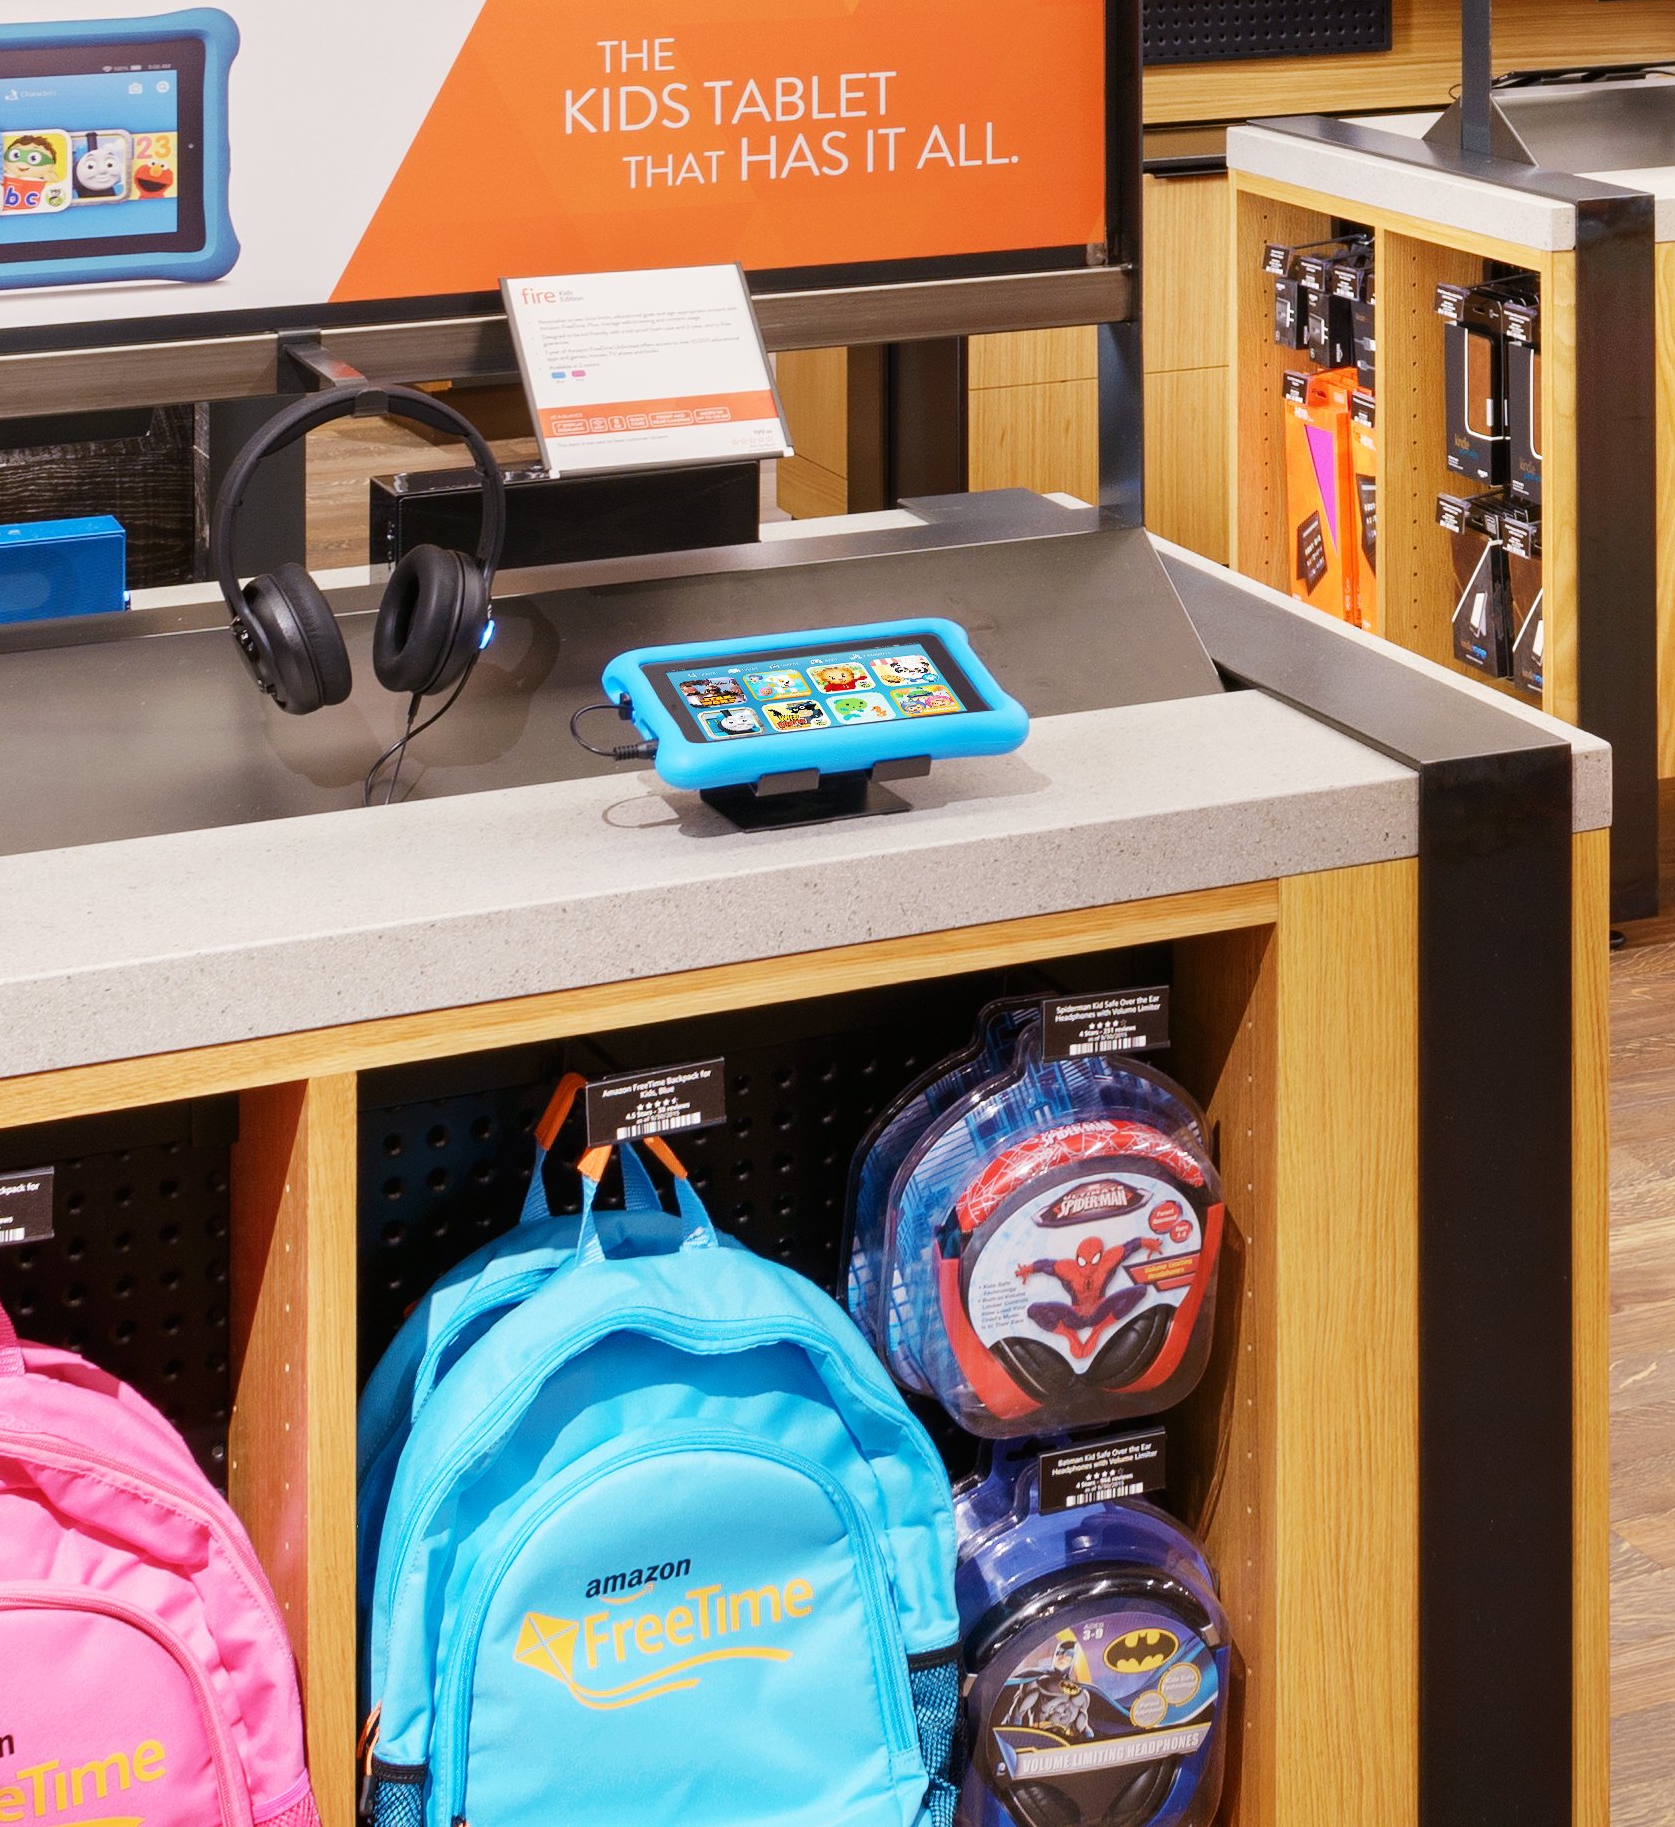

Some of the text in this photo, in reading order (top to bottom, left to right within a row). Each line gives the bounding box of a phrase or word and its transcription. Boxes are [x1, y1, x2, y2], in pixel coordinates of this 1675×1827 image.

[597, 38, 676, 72] THE
[565, 71, 897, 135] KIDS TABLET
[623, 121, 1019, 188] THAT HAS IT ALL.
[586, 1557, 692, 1599] amazon
[584, 1579, 814, 1670] FreeTime
[1023, 1733, 1199, 1772] VOLUME LIMITING HEADPHONES
